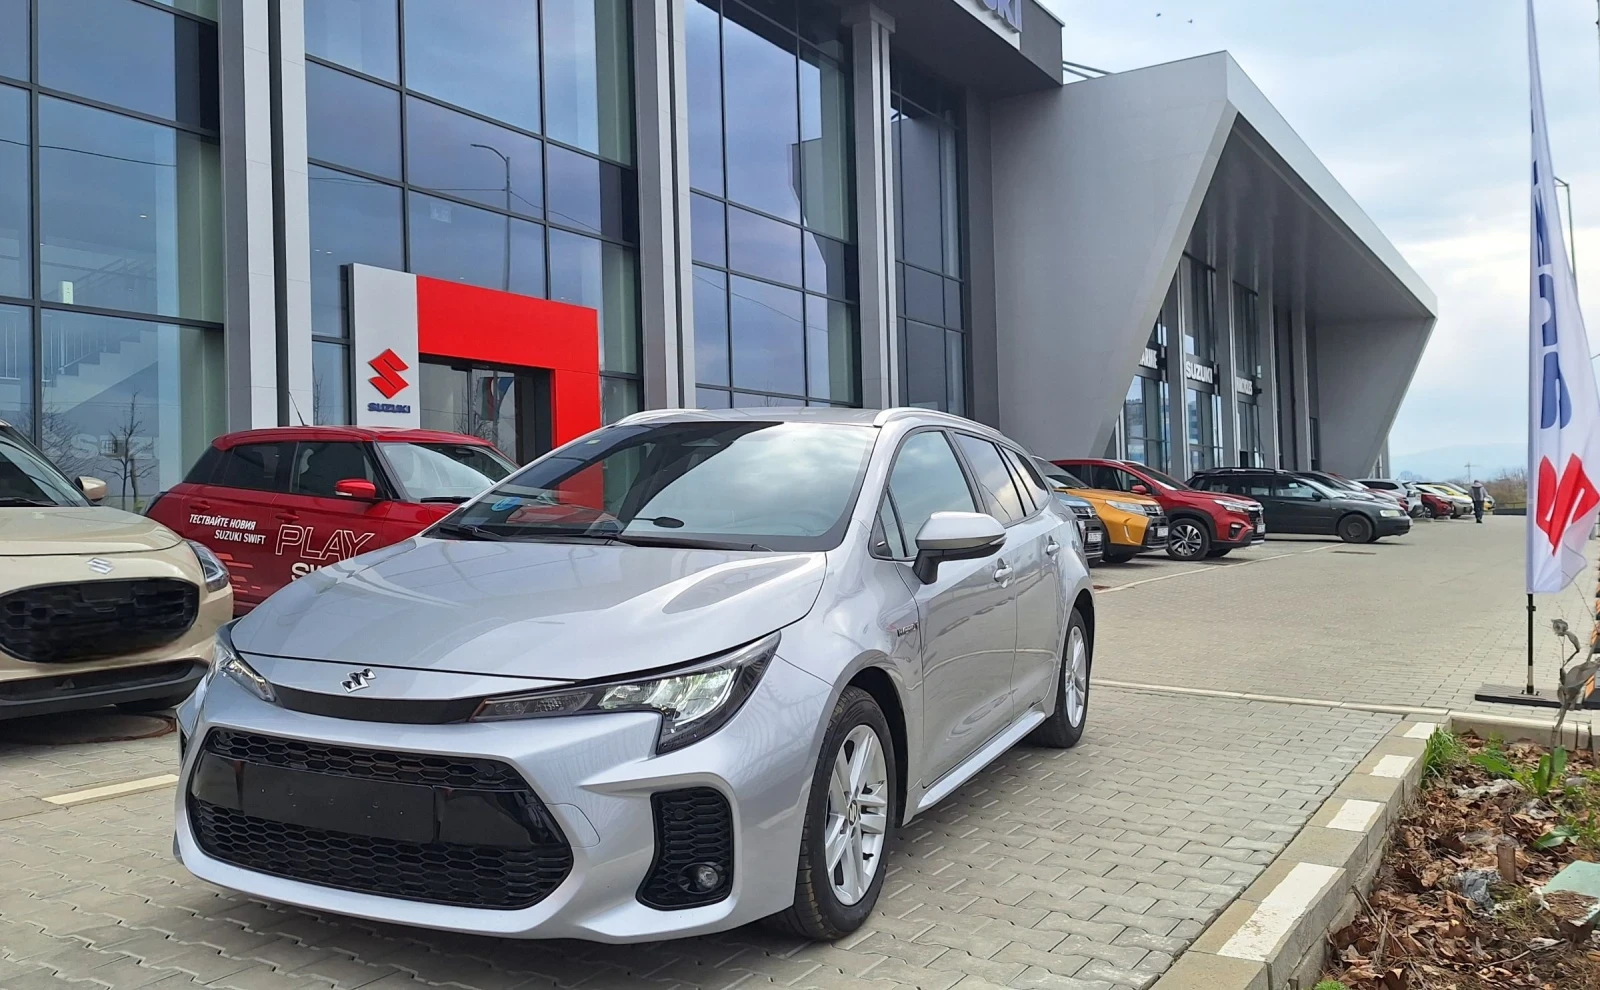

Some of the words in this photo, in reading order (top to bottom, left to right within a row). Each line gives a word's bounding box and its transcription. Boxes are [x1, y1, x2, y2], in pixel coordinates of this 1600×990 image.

[1185, 361, 1212, 383] SUZUKI
[368, 402, 411, 414] SUZUKI
[189, 513, 229, 528] ТЕСТВАЙТЕ
[229, 518, 257, 531] НОВИЯ
[213, 529, 242, 542] SUZUKI
[243, 532, 267, 545] SWIFT
[275, 523, 375, 561] PLAY
